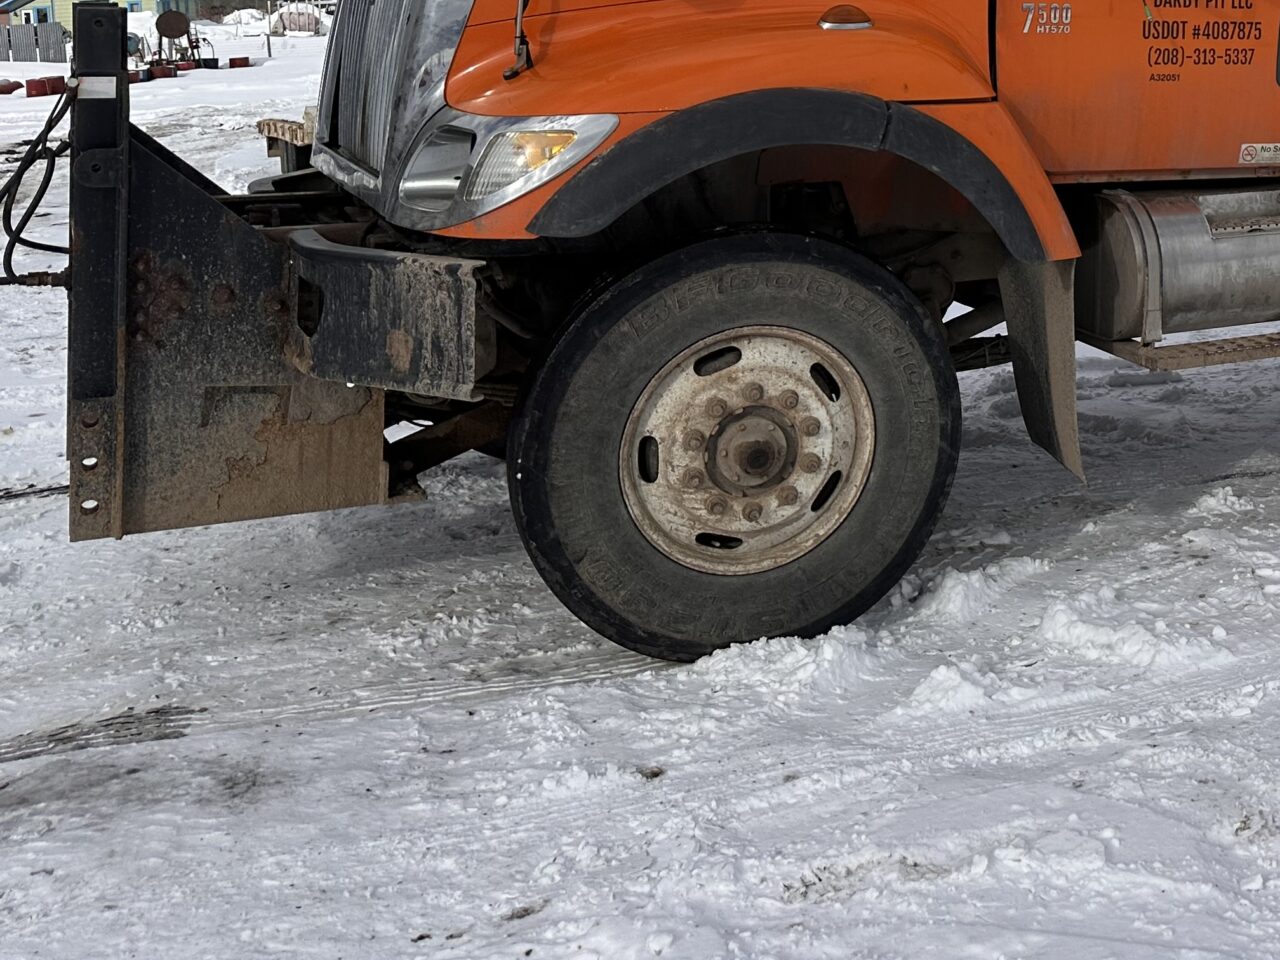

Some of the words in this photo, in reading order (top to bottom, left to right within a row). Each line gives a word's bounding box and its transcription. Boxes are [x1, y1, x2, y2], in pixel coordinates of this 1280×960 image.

[1022, 2, 1072, 33] 7500
[1036, 25, 1071, 34] HT570
[1142, 20, 1188, 40] USDOT
[1191, 21, 1262, 41] #4087875
[1147, 45, 1256, 68] (208)-313-5337
[1149, 73, 1180, 82] A32051
[1260, 144, 1272, 153] No
